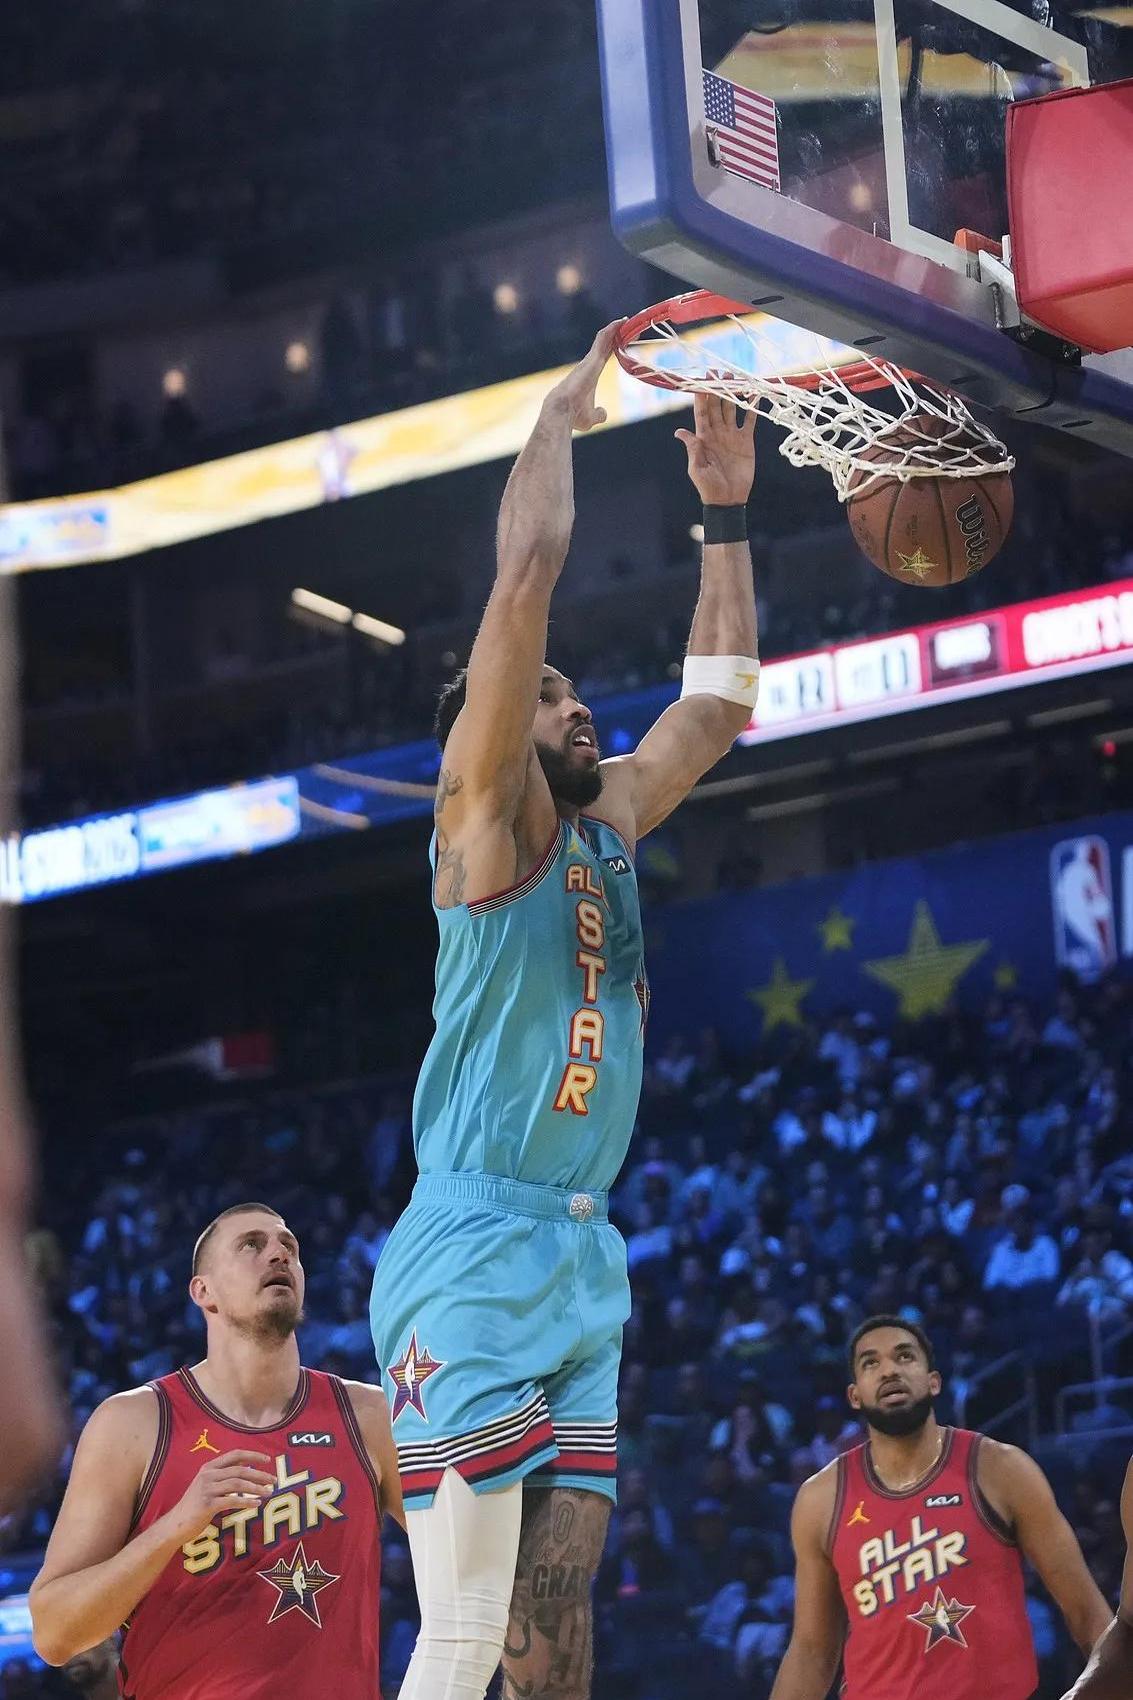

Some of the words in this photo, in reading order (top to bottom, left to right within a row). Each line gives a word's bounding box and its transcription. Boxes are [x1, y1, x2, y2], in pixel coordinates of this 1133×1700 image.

[565, 863, 604, 899] AL
[553, 899, 606, 1116] STAR
[291, 1433, 331, 1444] KIA
[182, 1476, 346, 1575] STAR
[859, 1515, 939, 1575] ALL
[853, 1530, 970, 1617] STAR
